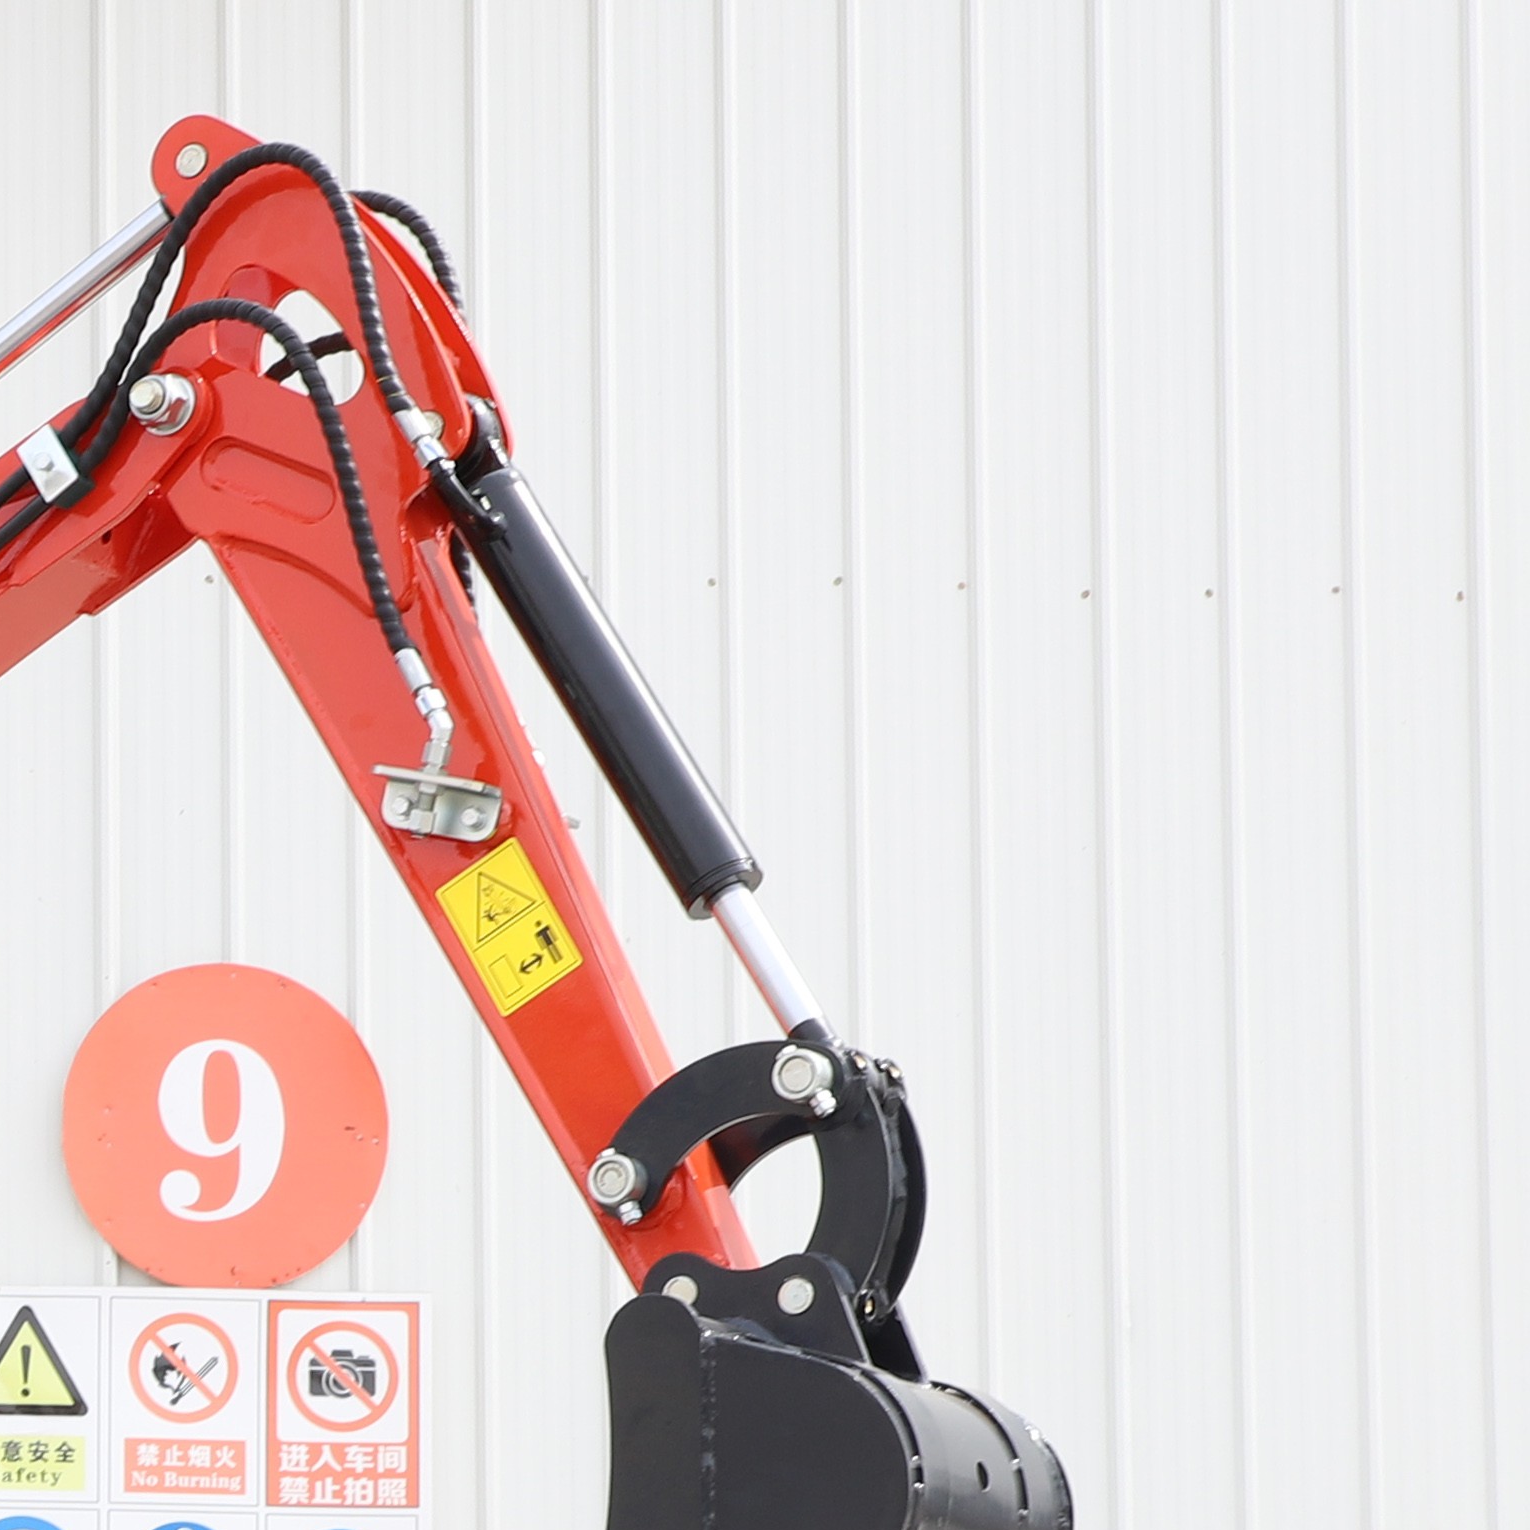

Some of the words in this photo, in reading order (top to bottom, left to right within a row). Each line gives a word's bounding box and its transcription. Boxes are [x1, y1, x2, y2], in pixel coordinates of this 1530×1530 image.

[158, 1038, 286, 1222] 9
[136, 1443, 237, 1468] 禁止烟火
[279, 1444, 408, 1473] 进入车间
[130, 1470, 159, 1488] No
[164, 1471, 242, 1491] Burning
[279, 1476, 408, 1506] 禁止拍照
